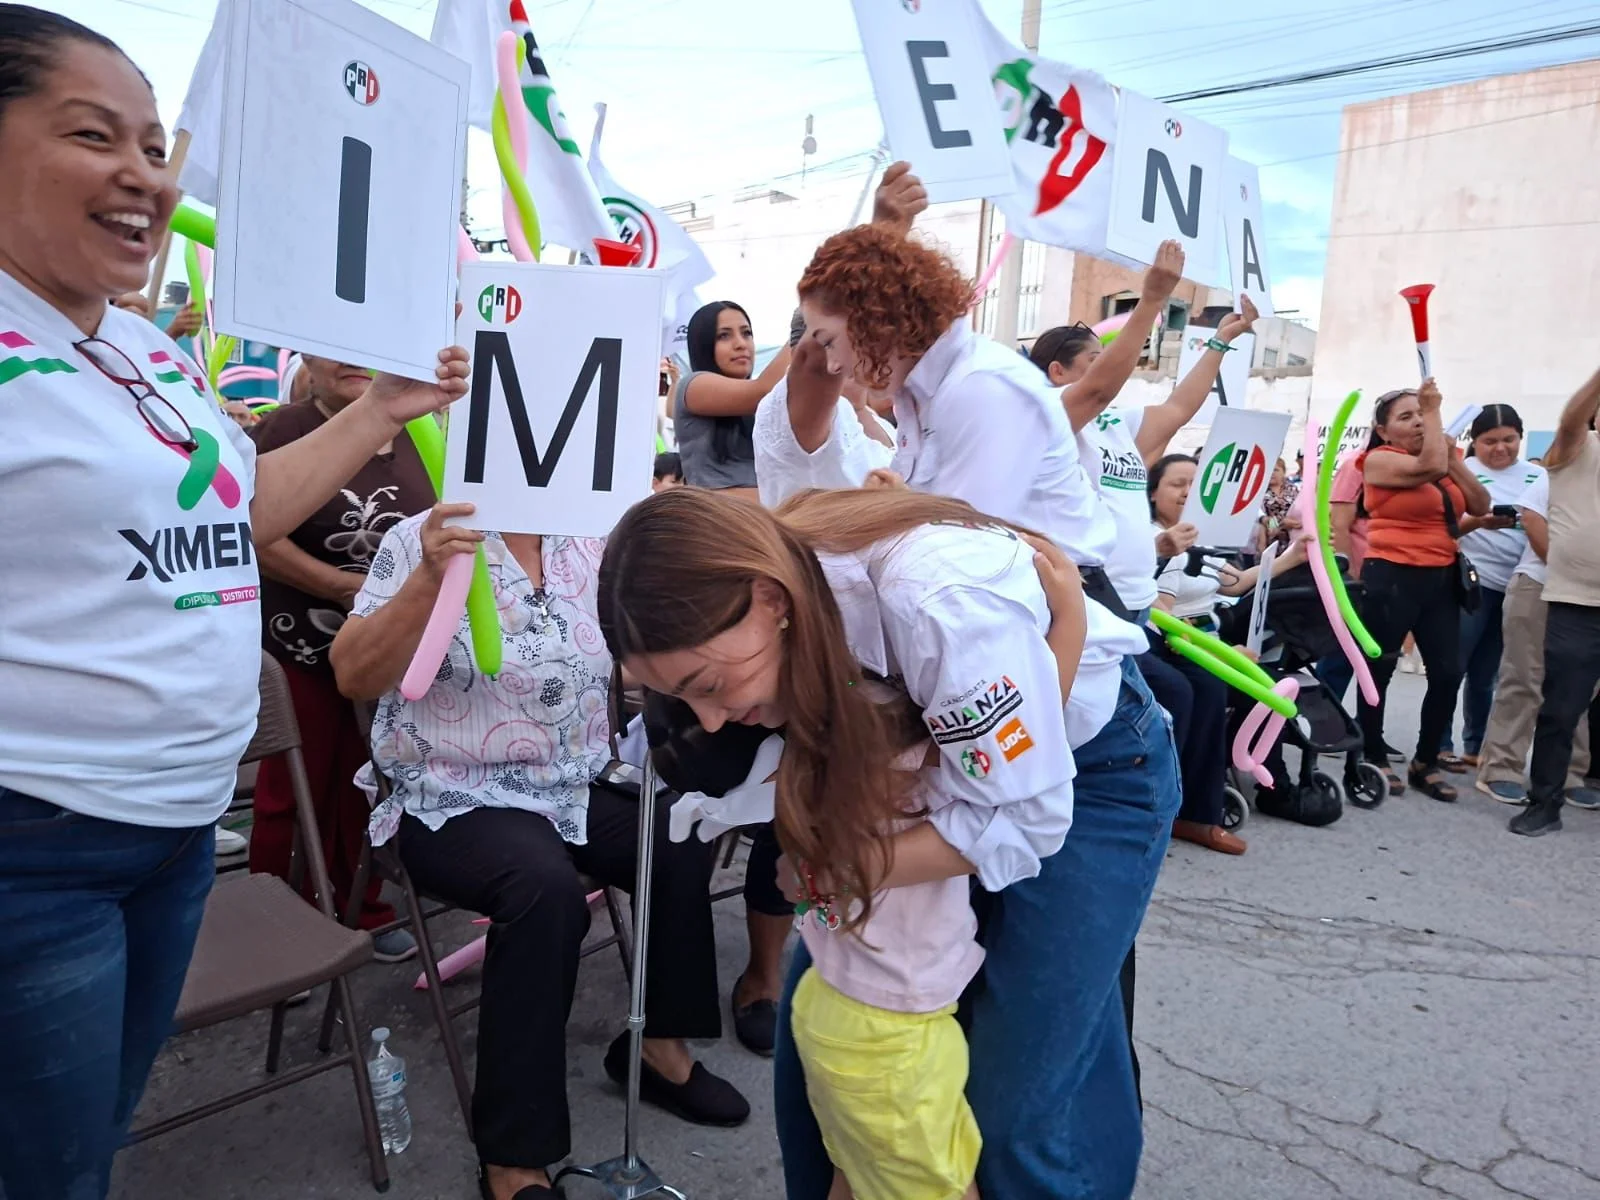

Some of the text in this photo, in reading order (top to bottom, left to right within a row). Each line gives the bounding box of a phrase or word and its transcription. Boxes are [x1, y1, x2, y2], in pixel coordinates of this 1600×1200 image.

[344, 65, 377, 100] PRI
[905, 40, 973, 149] E
[335, 136, 372, 303] I
[1142, 148, 1202, 239] N
[1243, 218, 1265, 292] A
[481, 286, 519, 318] PRI
[463, 330, 622, 492] M
[1202, 447, 1262, 504] PRI
[222, 588, 256, 602] DISTRITO
[927, 675, 1017, 731] ALIANZA
[961, 750, 989, 773] PRI
[1000, 726, 1027, 752] UDC
